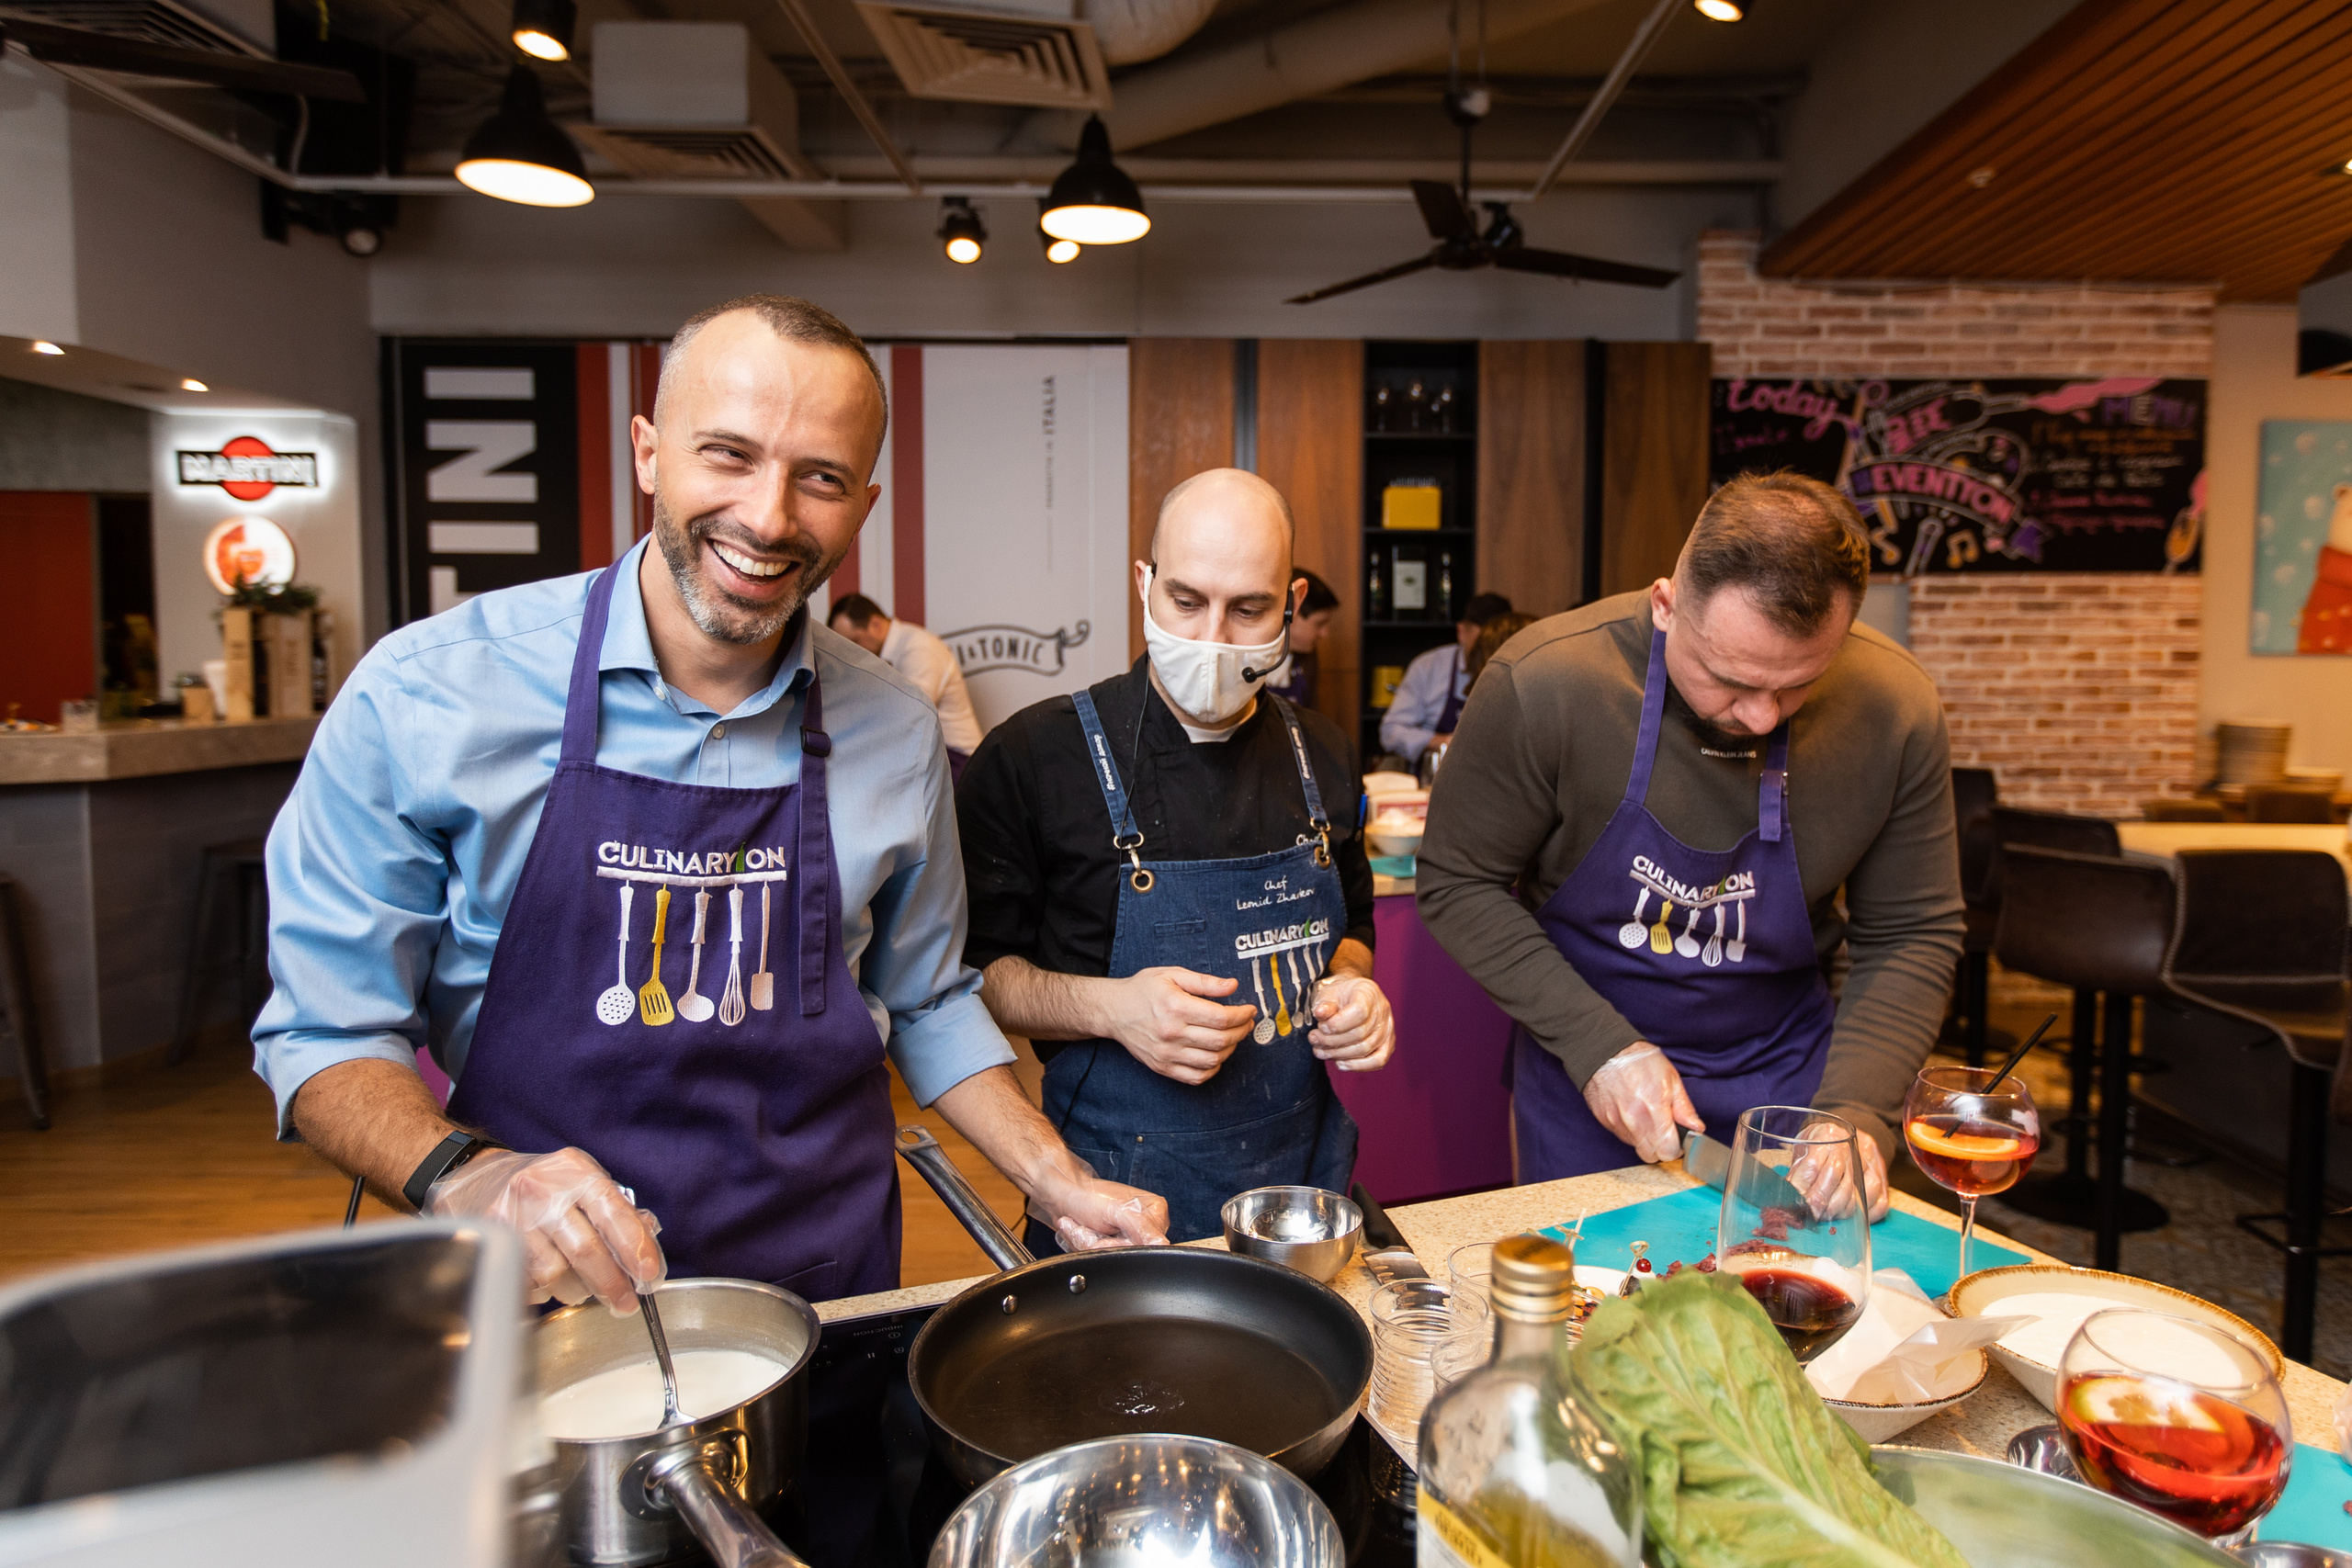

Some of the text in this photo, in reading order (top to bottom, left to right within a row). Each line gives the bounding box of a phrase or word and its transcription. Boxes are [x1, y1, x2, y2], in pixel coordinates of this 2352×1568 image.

[1042, 376, 1056, 435] ITALIA
[1263, 875, 1288, 891] Chef
[1236, 897, 1273, 910] Leonid
[853, 1325, 904, 1337] INDUCTION
